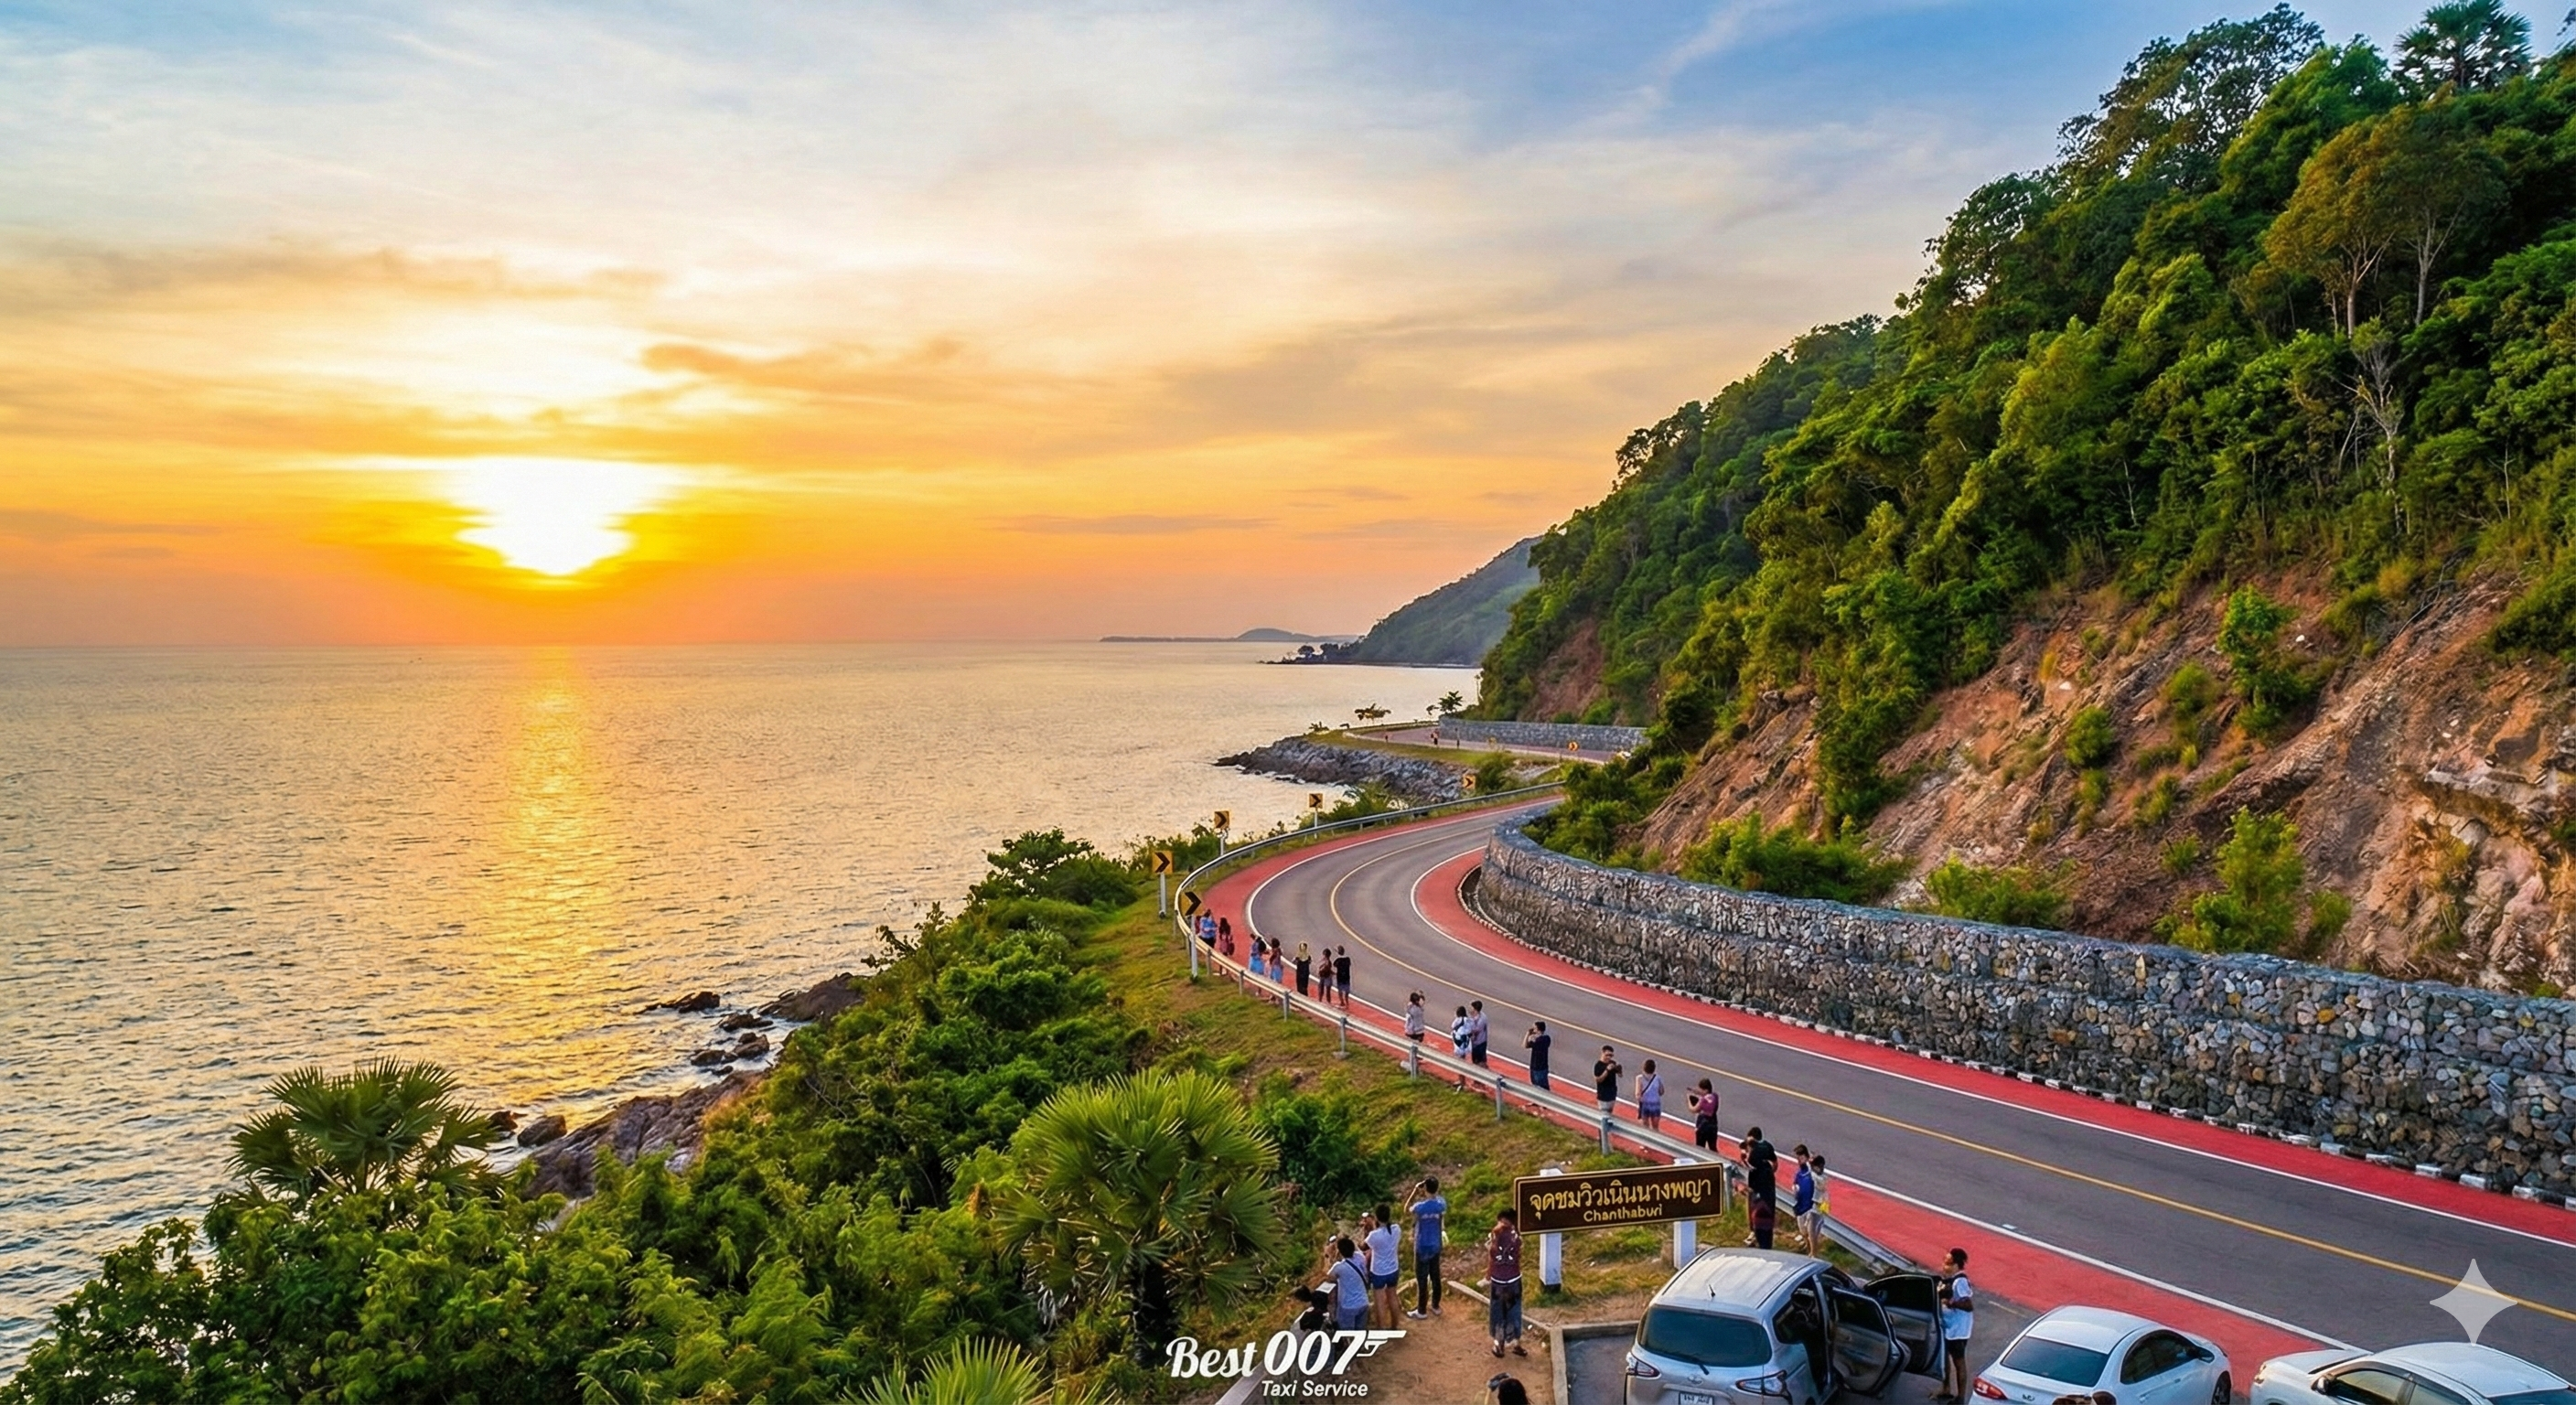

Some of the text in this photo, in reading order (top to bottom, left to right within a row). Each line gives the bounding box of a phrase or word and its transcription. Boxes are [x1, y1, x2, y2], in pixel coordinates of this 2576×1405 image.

[1530, 1178, 1712, 1220] จุดชมวิวเนินนางพญา
[1583, 1203, 1663, 1222] Chanthaburi
